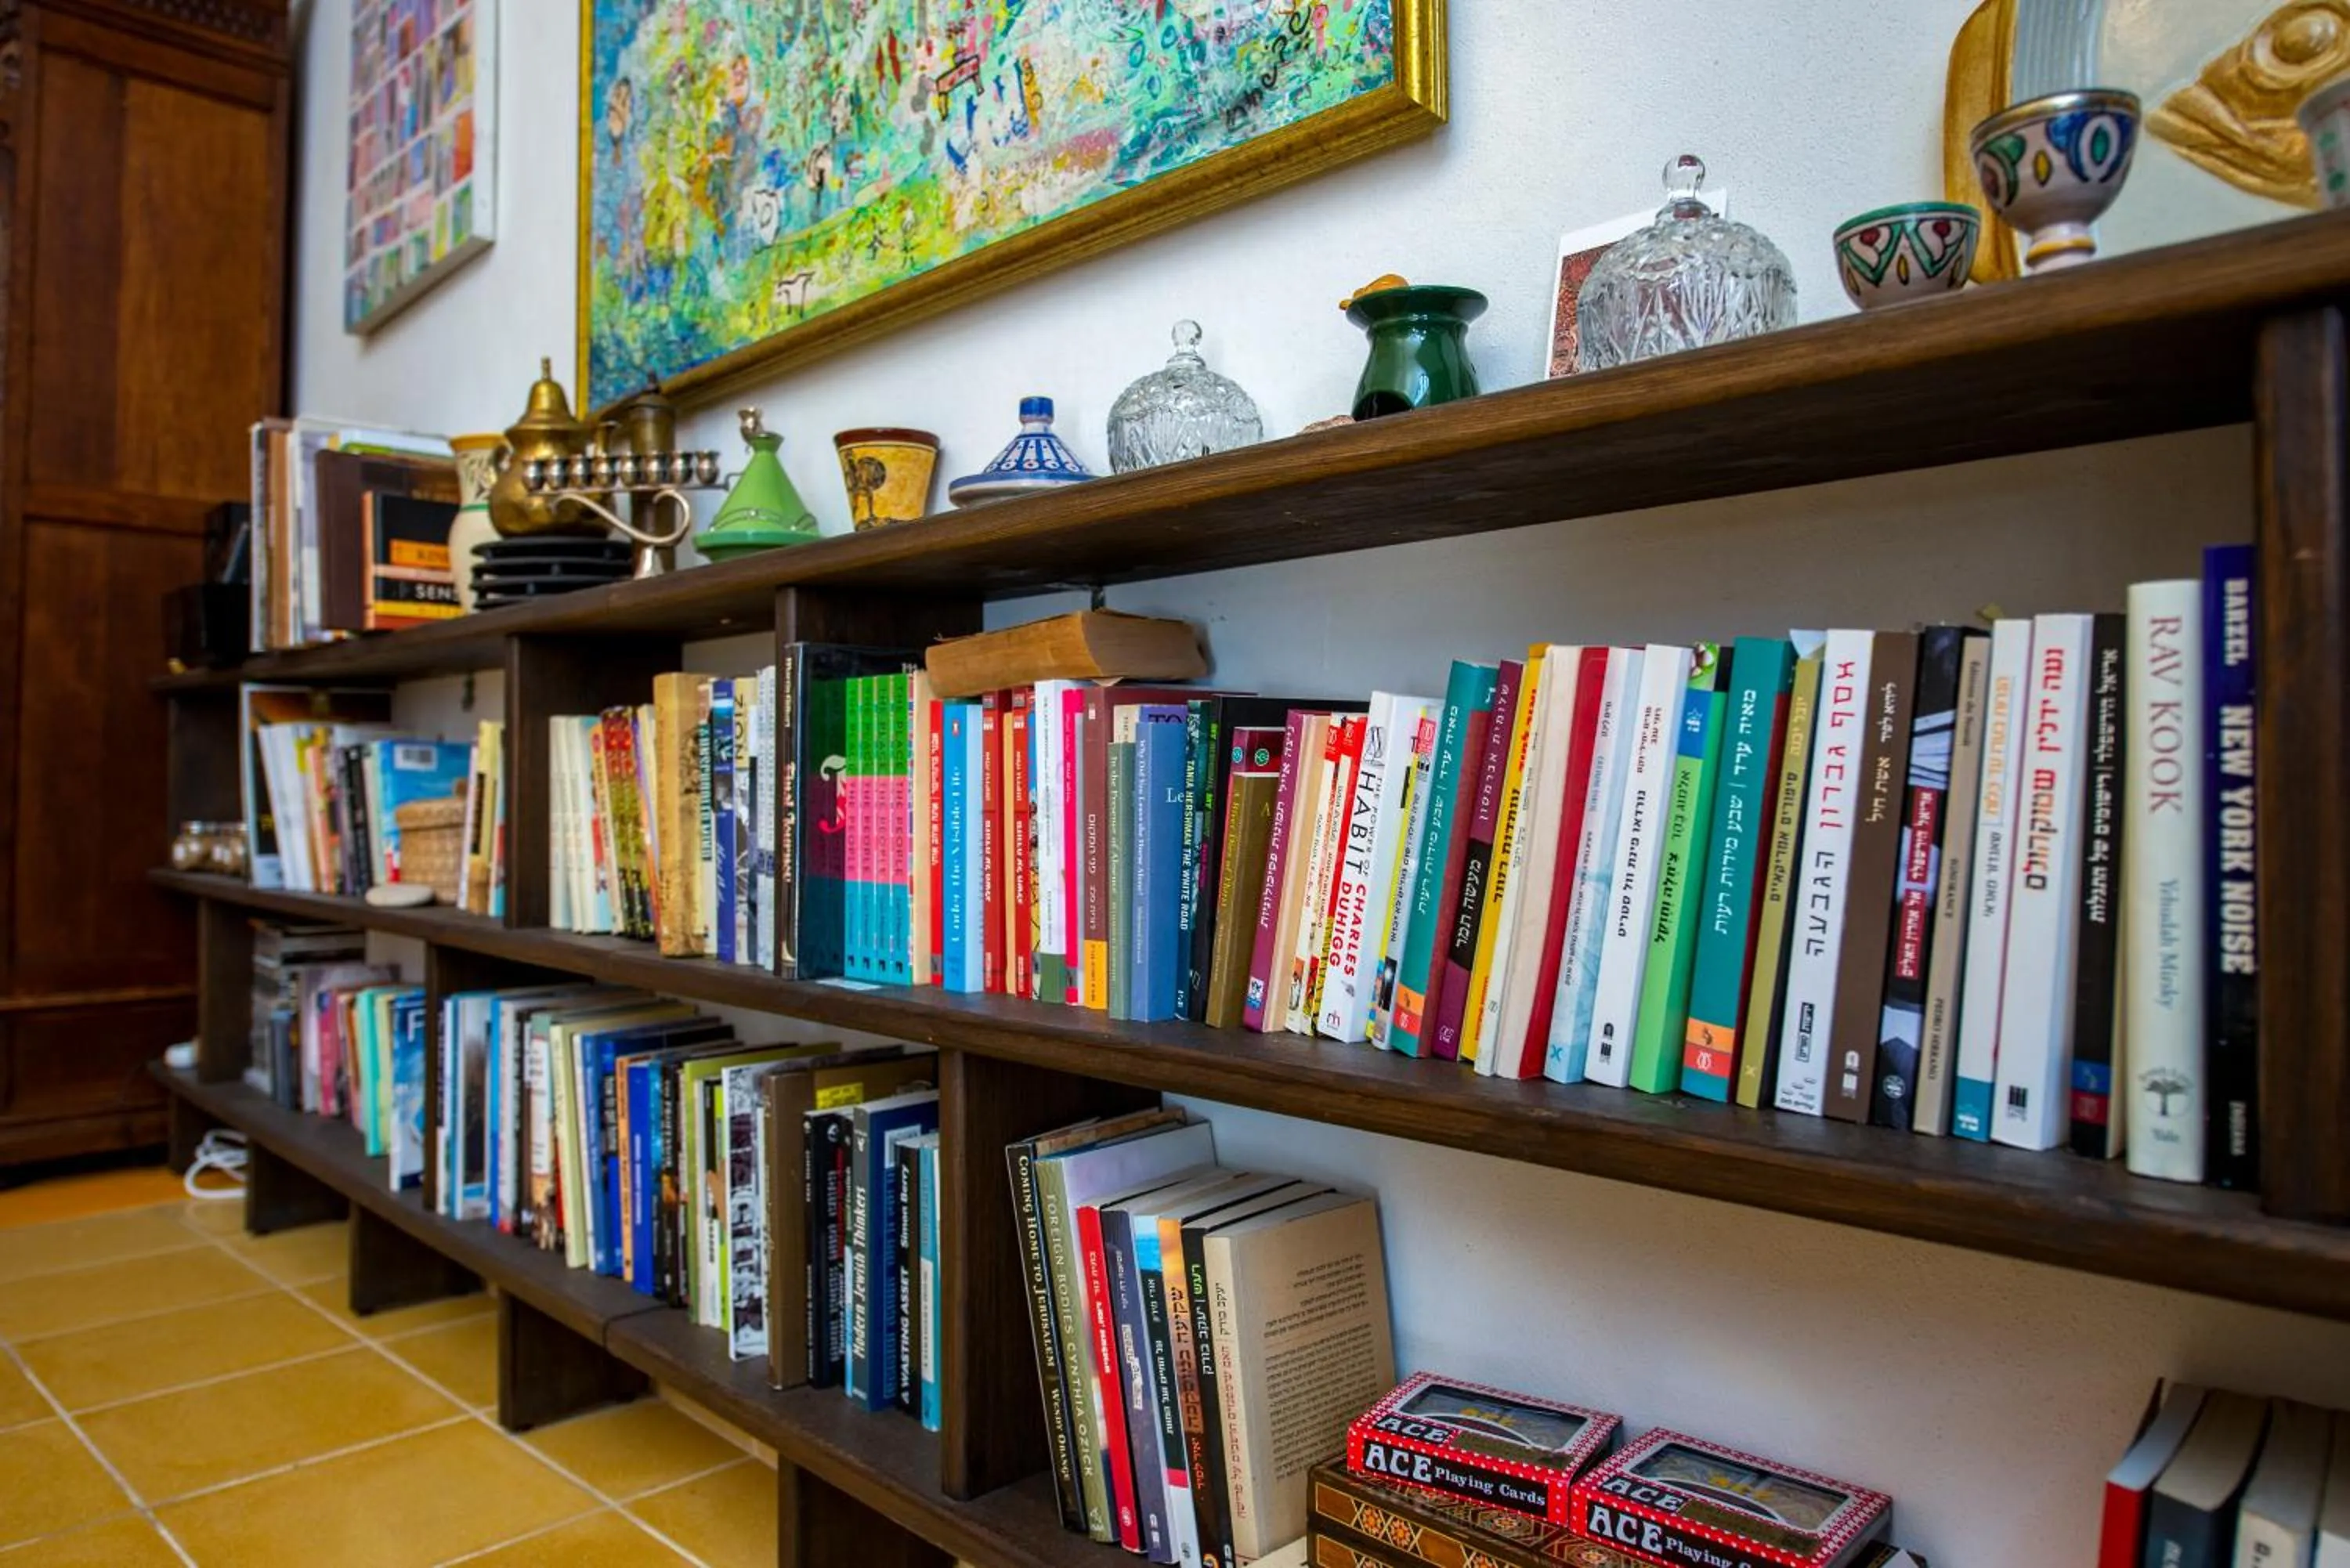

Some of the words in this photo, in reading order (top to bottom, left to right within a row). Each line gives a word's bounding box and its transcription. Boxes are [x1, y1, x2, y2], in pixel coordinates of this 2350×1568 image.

[2224, 578, 2249, 666] BARZEL
[2042, 649, 2063, 690] נעה
[2095, 649, 2117, 692] אריאל
[2149, 616, 2182, 687] RAV
[783, 695, 792, 728] Gilbert
[1739, 689, 1755, 735] מאיה
[1831, 659, 1855, 728] אסף
[735, 694, 743, 761] ZION
[1443, 706, 1459, 744] מאיה
[1491, 684, 1509, 744] שלומית
[1877, 717, 1893, 742] לפיד
[2035, 699, 2061, 752] ידלין
[2094, 698, 2117, 761] הירשפלד
[1135, 739, 1147, 757] Why
[1281, 725, 1296, 757] ניצה
[1734, 741, 1753, 776] ערד
[2148, 700, 2182, 815] KOOK
[2221, 705, 2253, 776] NEW
[950, 766, 959, 796] Life
[1109, 757, 1119, 769] In
[1109, 772, 1119, 786] the
[1137, 761, 1147, 776] Did
[1185, 761, 1195, 789] TANIA
[1277, 762, 1292, 792] אייל
[1438, 750, 1454, 779] ערד
[1876, 757, 1891, 790] אשת
[783, 761, 795, 807] Final
[1137, 778, 1146, 795] You
[1373, 776, 1383, 798] THE
[1480, 752, 1500, 821] אברמסון
[1780, 771, 1797, 825] סיפורים
[1818, 745, 1846, 829] גברון
[1108, 789, 1119, 836] Presence
[1136, 797, 1146, 821] Leave
[1183, 791, 1194, 845] HERSHMAN
[1230, 801, 1239, 829] River
[1345, 771, 1376, 875] HABIT
[1430, 796, 1446, 826] שבע
[1633, 790, 1646, 833] נורדאו
[1726, 795, 1744, 833] שבע
[1865, 797, 1885, 822] חיל
[1913, 792, 1932, 826] אריאל
[2093, 775, 2113, 834] רישומים
[950, 801, 960, 854] Visible
[1109, 838, 1119, 849] of
[1136, 823, 1144, 836] the
[1271, 801, 1285, 849] תמונות
[1365, 811, 1379, 853] POWER
[2023, 769, 2057, 890] שטוקהולם
[2220, 786, 2253, 872] YORK
[782, 812, 795, 883] Journey
[1136, 839, 1146, 864] Horse
[1182, 848, 1191, 866] THE
[1224, 859, 1234, 873] of
[1426, 833, 1440, 873] מידות
[1628, 838, 1638, 868] פינת
[1720, 838, 1738, 887] מידות
[1770, 831, 1790, 902] אמריקאיים
[1911, 830, 1928, 880] הירשפלד
[2088, 840, 2109, 862] של
[950, 860, 960, 886] the
[1109, 851, 1119, 894] Absence
[1135, 866, 1146, 896] Alone?
[1180, 869, 1191, 901] WHITE
[1361, 859, 1371, 877] OF
[1463, 860, 1482, 909] מעשה
[1622, 873, 1633, 891] וול
[1260, 853, 1278, 928] פסיכולוגיות
[1416, 876, 1432, 915] רעות
[1806, 851, 1835, 956] הגבעה
[1906, 892, 1922, 907] אל
[1945, 858, 1958, 918] IGNORANCE
[1180, 904, 1189, 930] ROAD
[1329, 882, 1352, 966] DUHIGG
[1344, 885, 1366, 977] CHARLES
[1455, 913, 1474, 948] תמר
[1618, 895, 1631, 937] סטריט
[1713, 891, 1732, 934] רעות
[1905, 910, 1921, 940] אחרון
[2160, 879, 2179, 947] Yehudah
[2221, 880, 2254, 974] NOISE
[1900, 943, 1914, 977] האלים
[2156, 952, 2179, 1009] Mirsky
[1932, 998, 1944, 1031] PEDRO
[1928, 1034, 1941, 1079] SERRANO
[606, 1076, 615, 1095] how
[606, 1098, 616, 1107] to
[605, 1110, 616, 1123] get
[608, 1125, 618, 1151] home
[901, 1164, 909, 1202] Berry
[1018, 1155, 1034, 1213] COMING
[854, 1186, 866, 1248] Thinkers
[1027, 1216, 1041, 1260] HOME
[853, 1252, 866, 1299] Jewish
[1033, 1263, 1043, 1283] TO
[1046, 1193, 1064, 1266] FOREIGN
[1057, 1274, 1074, 1334] BODIES
[1191, 1263, 1203, 1295] רעש
[901, 1266, 909, 1314] ASSET
[1215, 1282, 1227, 1308] יעקב
[854, 1302, 866, 1358] Modern
[1032, 1284, 1055, 1367] JERUSALEM
[1171, 1285, 1191, 1343] שקיעה
[1195, 1305, 1209, 1339] יעקב
[1217, 1310, 1229, 1335] בורק
[901, 1317, 909, 1387] WASTING
[1156, 1340, 1164, 1352] על
[1201, 1342, 1214, 1375] בורק
[1220, 1346, 1231, 1367] האם
[1157, 1357, 1167, 1383] החיים
[1177, 1349, 1198, 1428] במוסקבה
[901, 1391, 909, 1404] A
[1067, 1342, 1084, 1417] CYNTHIA
[1078, 1424, 1094, 1478] OZICK
[1050, 1389, 1063, 1431] WENDY
[1058, 1433, 1071, 1481] ORANGE
[1191, 1437, 1202, 1459] יאיר
[1229, 1422, 1241, 1462] חושבים
[1376, 1416, 1450, 1443] ACE
[1193, 1462, 1206, 1490] לפיד
[1231, 1465, 1241, 1479] על
[1365, 1443, 1434, 1486] ACE
[1434, 1467, 1495, 1497] Playing
[1498, 1483, 1546, 1508] Cards
[1234, 1483, 1246, 1519] פרישה
[1601, 1475, 1683, 1511] ACE
[1589, 1506, 1665, 1554] ACE
[1665, 1537, 1731, 1567] Playing
